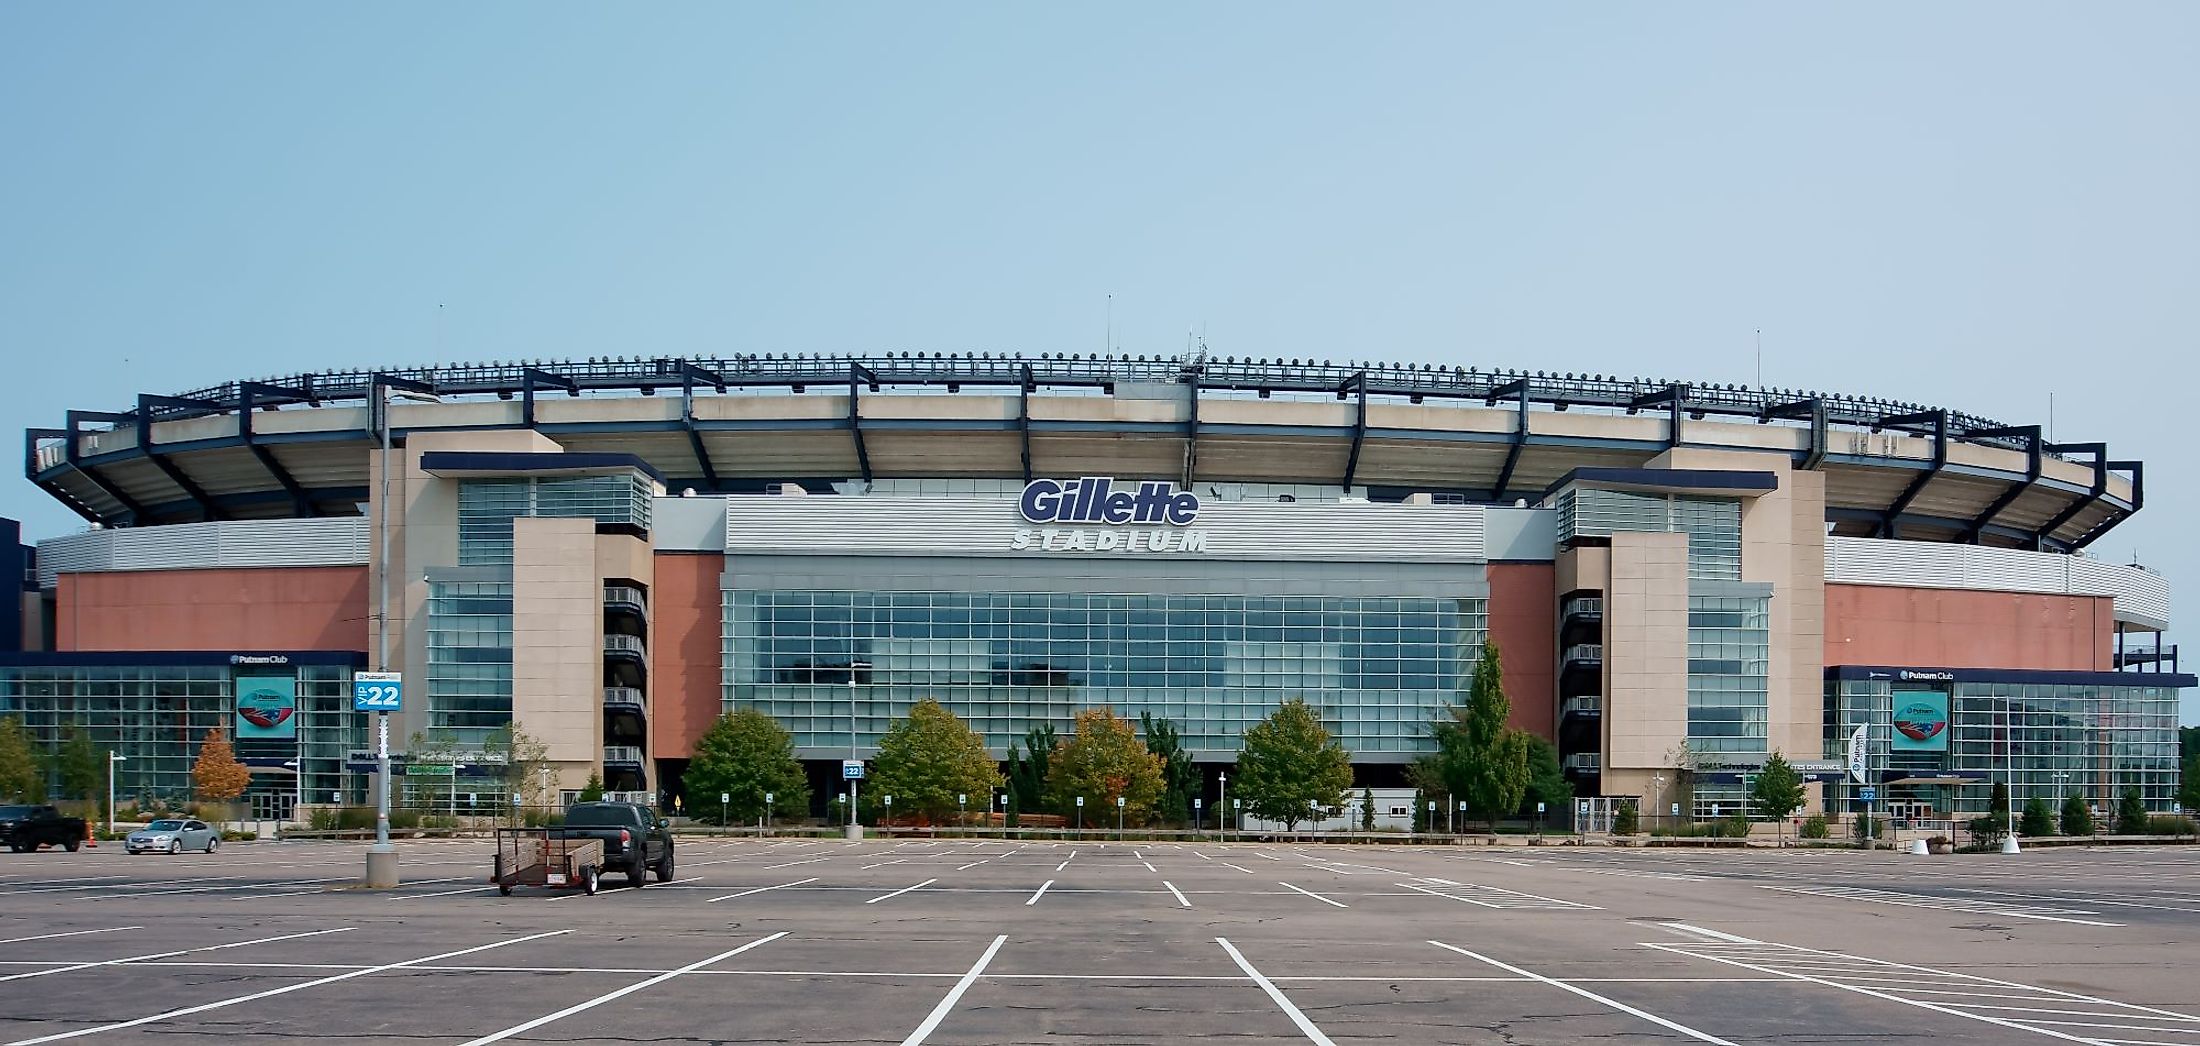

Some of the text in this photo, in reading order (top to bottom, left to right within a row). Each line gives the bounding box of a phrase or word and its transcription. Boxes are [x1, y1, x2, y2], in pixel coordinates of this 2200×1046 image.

[1020, 477, 1200, 525] Gillette
[1010, 529, 1207, 552] STADIUM
[239, 655, 288, 664] Putnam Club
[1908, 671, 1954, 680] Putnam Club
[357, 686, 368, 705] VIP
[367, 686, 399, 705] 22
[850, 767, 859, 775] 22
[1863, 792, 1874, 800] 22
